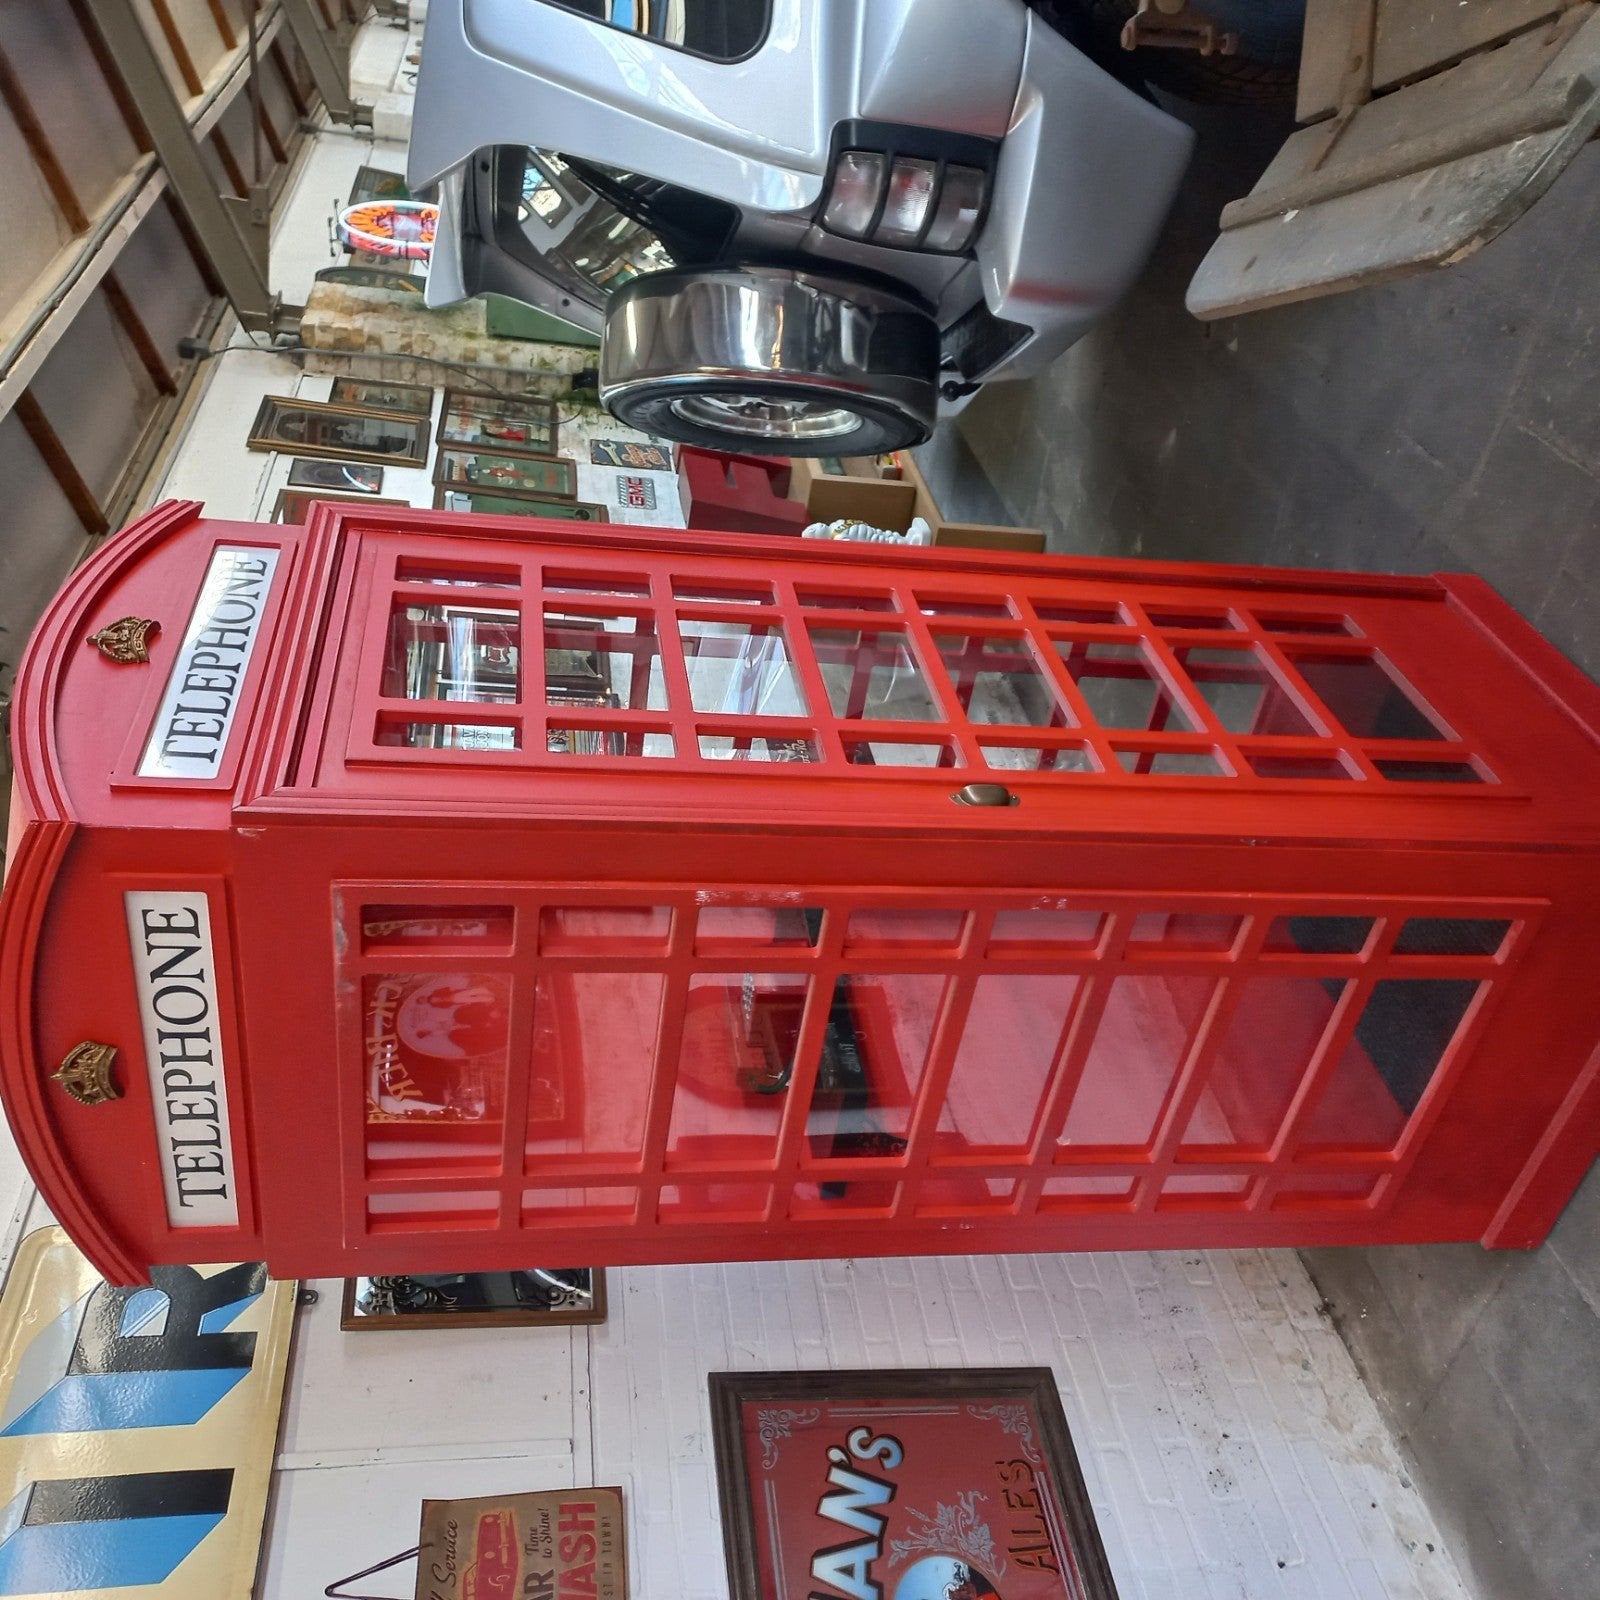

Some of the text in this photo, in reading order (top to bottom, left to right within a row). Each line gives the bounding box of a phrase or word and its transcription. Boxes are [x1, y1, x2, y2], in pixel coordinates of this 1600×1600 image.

[626, 476, 646, 507] GMC
[156, 557, 268, 769] TELEPHONE
[142, 906, 227, 1209] TELEPHONE
[524, 1526, 540, 1556] Time
[537, 1508, 553, 1558] to Shine!
[601, 1516, 612, 1554] TOWN!
[806, 1426, 904, 1600] AN'S
[995, 1458, 1058, 1575] ALES
[431, 1519, 458, 1588] Service
[602, 1563, 613, 1575] IN
